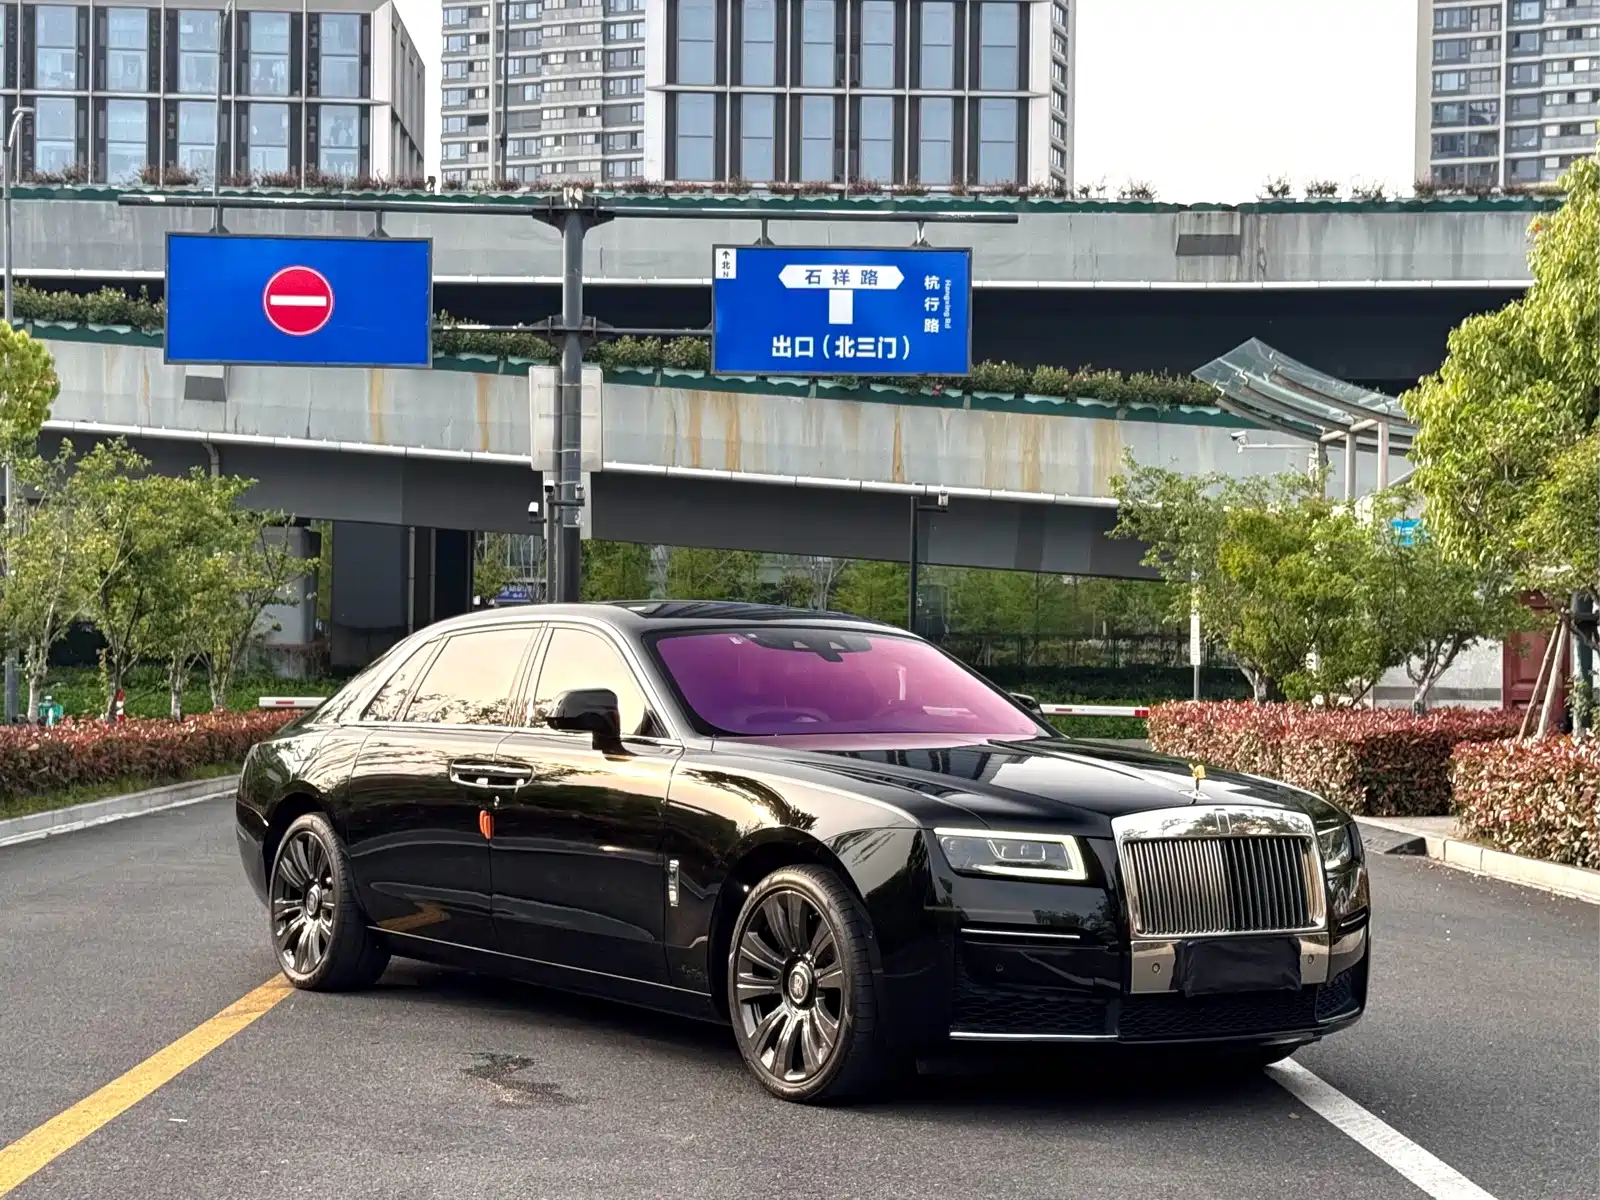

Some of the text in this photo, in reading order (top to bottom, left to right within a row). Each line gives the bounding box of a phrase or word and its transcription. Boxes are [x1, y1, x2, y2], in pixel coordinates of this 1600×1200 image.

[721, 260, 731, 270] 北
[804, 269, 879, 286] 石祥路
[923, 274, 940, 333] 杭行路
[944, 318, 952, 329] Rd
[771, 334, 910, 360] 出口（北三门）
